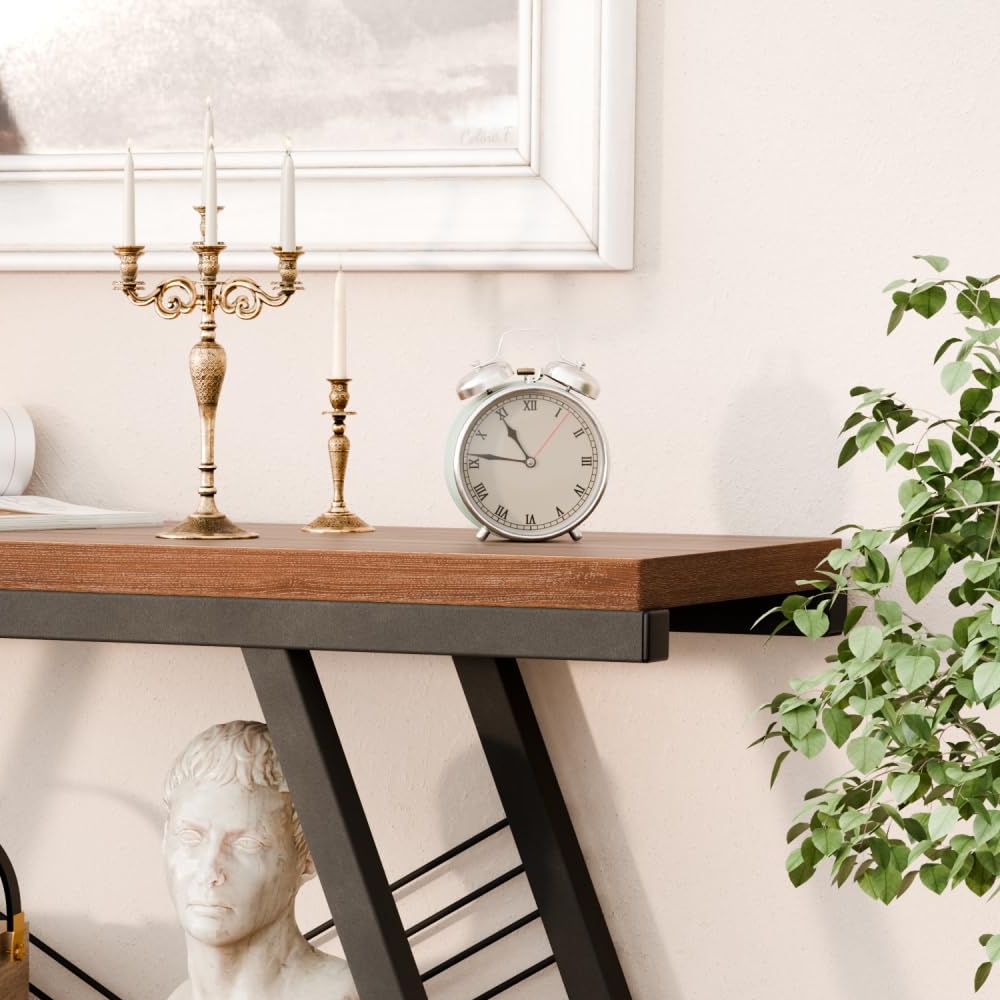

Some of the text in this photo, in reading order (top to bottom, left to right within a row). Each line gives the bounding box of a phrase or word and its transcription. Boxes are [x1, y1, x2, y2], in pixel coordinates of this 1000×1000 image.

[523, 400, 537, 411] XII
[554, 408, 562, 417] I
[475, 430, 487, 440] X
[573, 428, 585, 438] II
[581, 456, 592, 466] III
[555, 506, 564, 517] V
